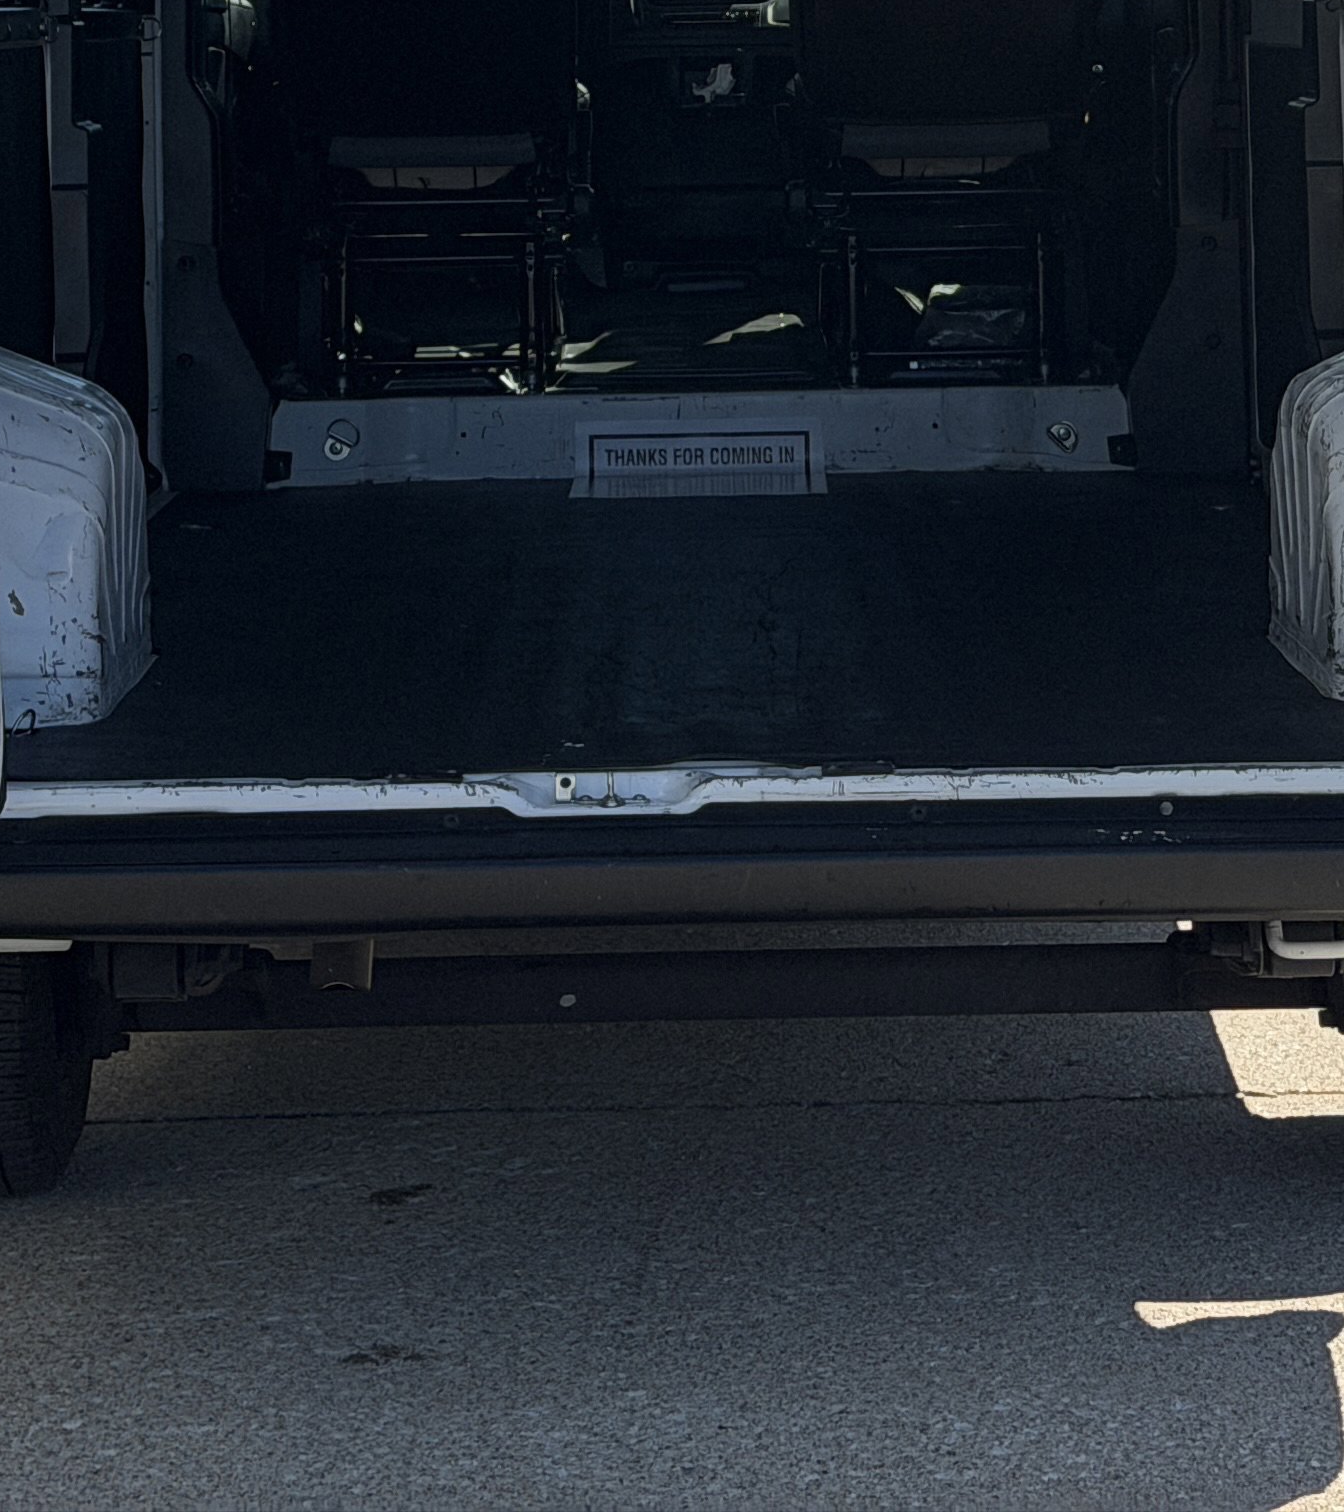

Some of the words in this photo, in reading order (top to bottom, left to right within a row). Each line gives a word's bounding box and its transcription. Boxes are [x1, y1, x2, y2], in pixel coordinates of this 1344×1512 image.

[604, 447, 668, 467] THANKS
[673, 447, 705, 466] FOR
[710, 445, 774, 465] COMING
[779, 445, 795, 464] IN
